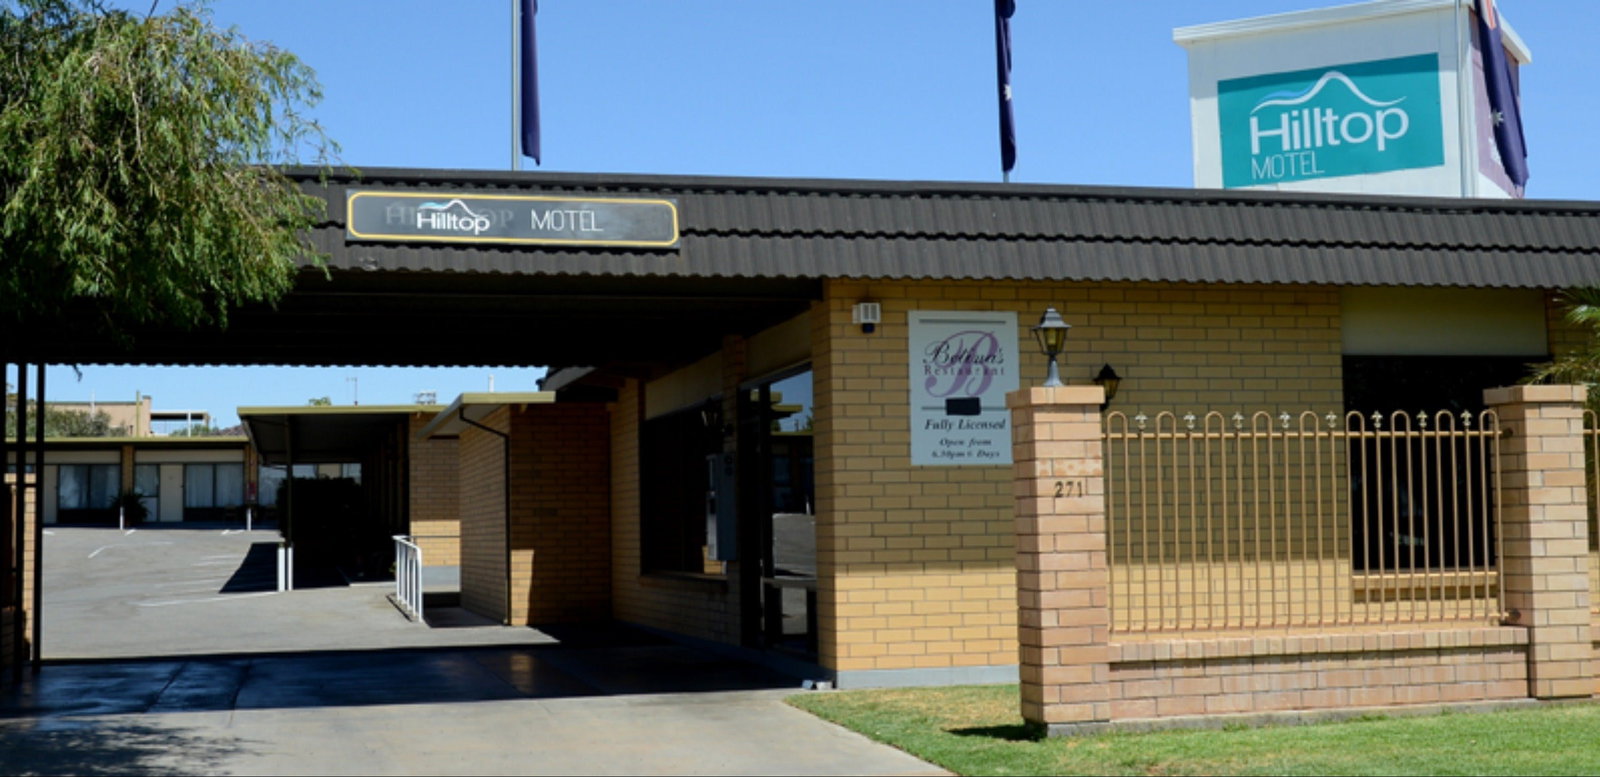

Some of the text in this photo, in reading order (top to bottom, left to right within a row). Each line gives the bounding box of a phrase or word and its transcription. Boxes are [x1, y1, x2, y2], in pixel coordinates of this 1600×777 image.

[1249, 106, 1410, 156] Hilltop
[1251, 150, 1325, 180] MOTEL
[416, 208, 604, 236] Hilltop MOTEL
[924, 365, 1005, 376] Restaurant
[924, 418, 1006, 432] Fully Licensed
[939, 437, 992, 448] Open from
[1055, 481, 1082, 498] 271
